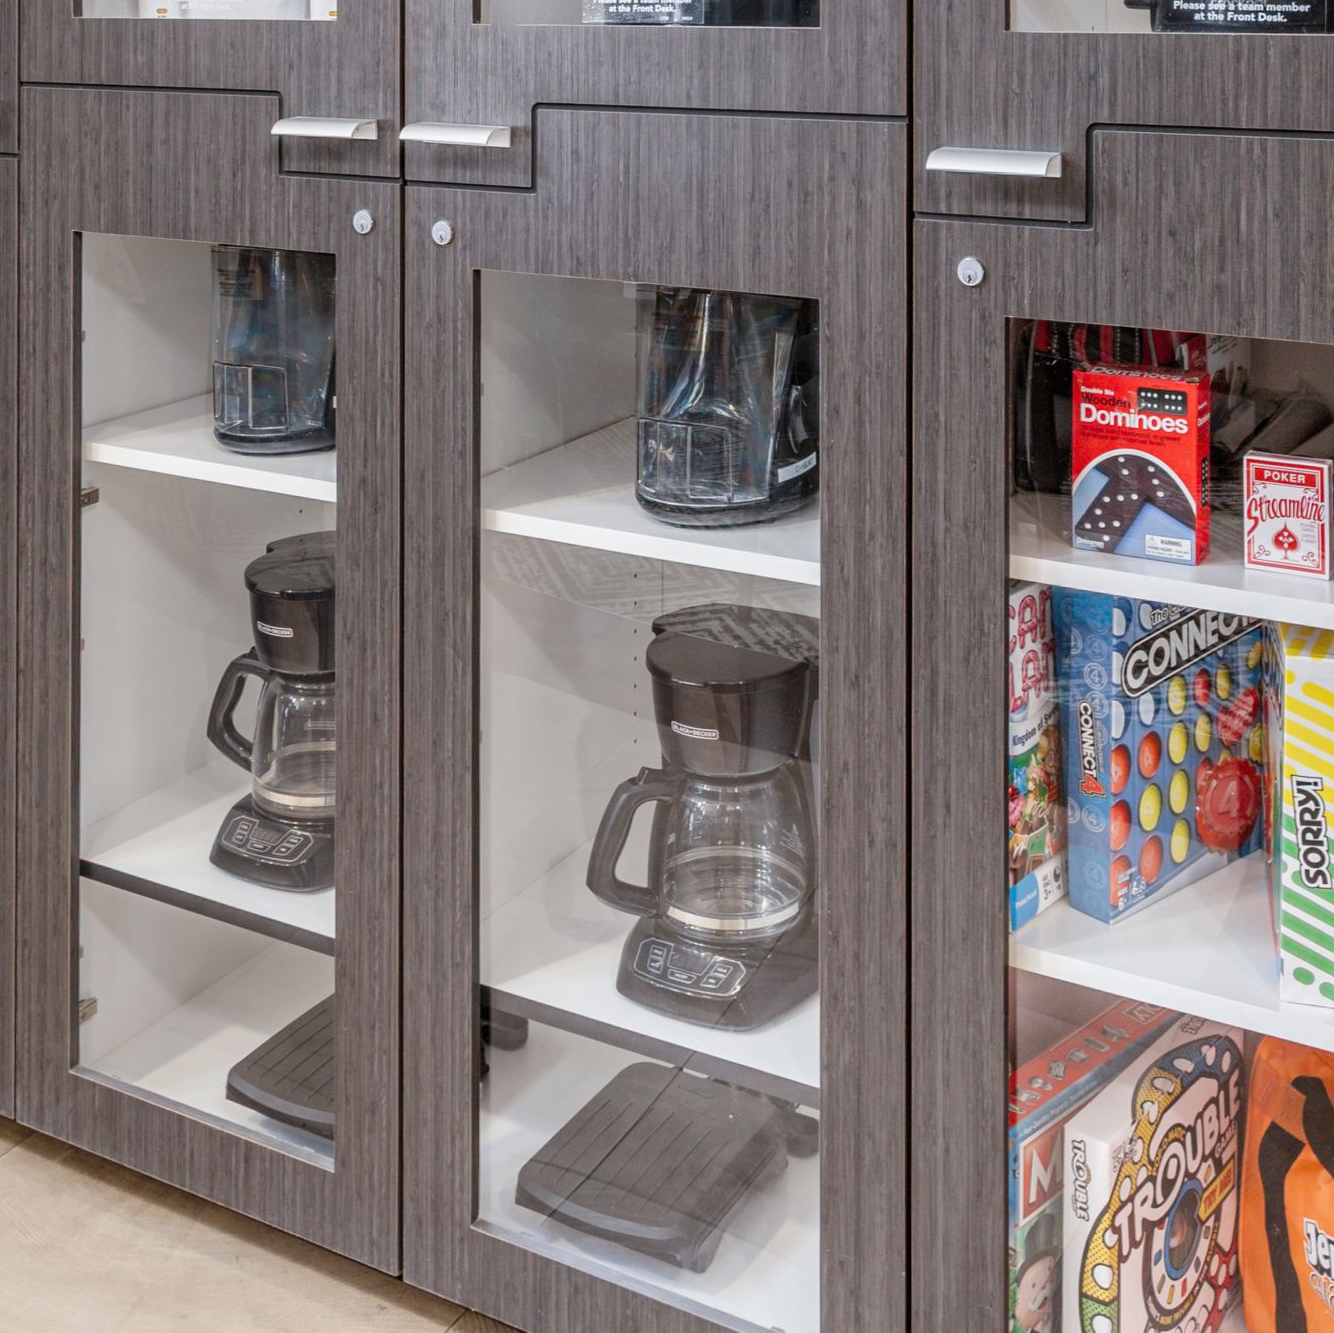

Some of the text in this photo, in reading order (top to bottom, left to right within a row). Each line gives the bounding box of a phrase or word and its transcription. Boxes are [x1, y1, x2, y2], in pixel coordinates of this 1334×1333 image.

[618, 4, 631, 12] the
[1173, 0, 1311, 12] Please see a team member
[1194, 11, 1288, 22] at the Front Desk.
[1081, 393, 1131, 408] Wooden
[1080, 403, 1188, 434] Dominoes
[1264, 470, 1306, 484] POKER
[1247, 495, 1325, 539] Streamline
[1080, 702, 1105, 796] CONNECT 4
[1295, 779, 1328, 885] SORRY!
[1216, 1121, 1236, 1158] GAME
[1114, 1068, 1240, 1257] TROUBLE
[1071, 1139, 1090, 1222] TROUBLE
